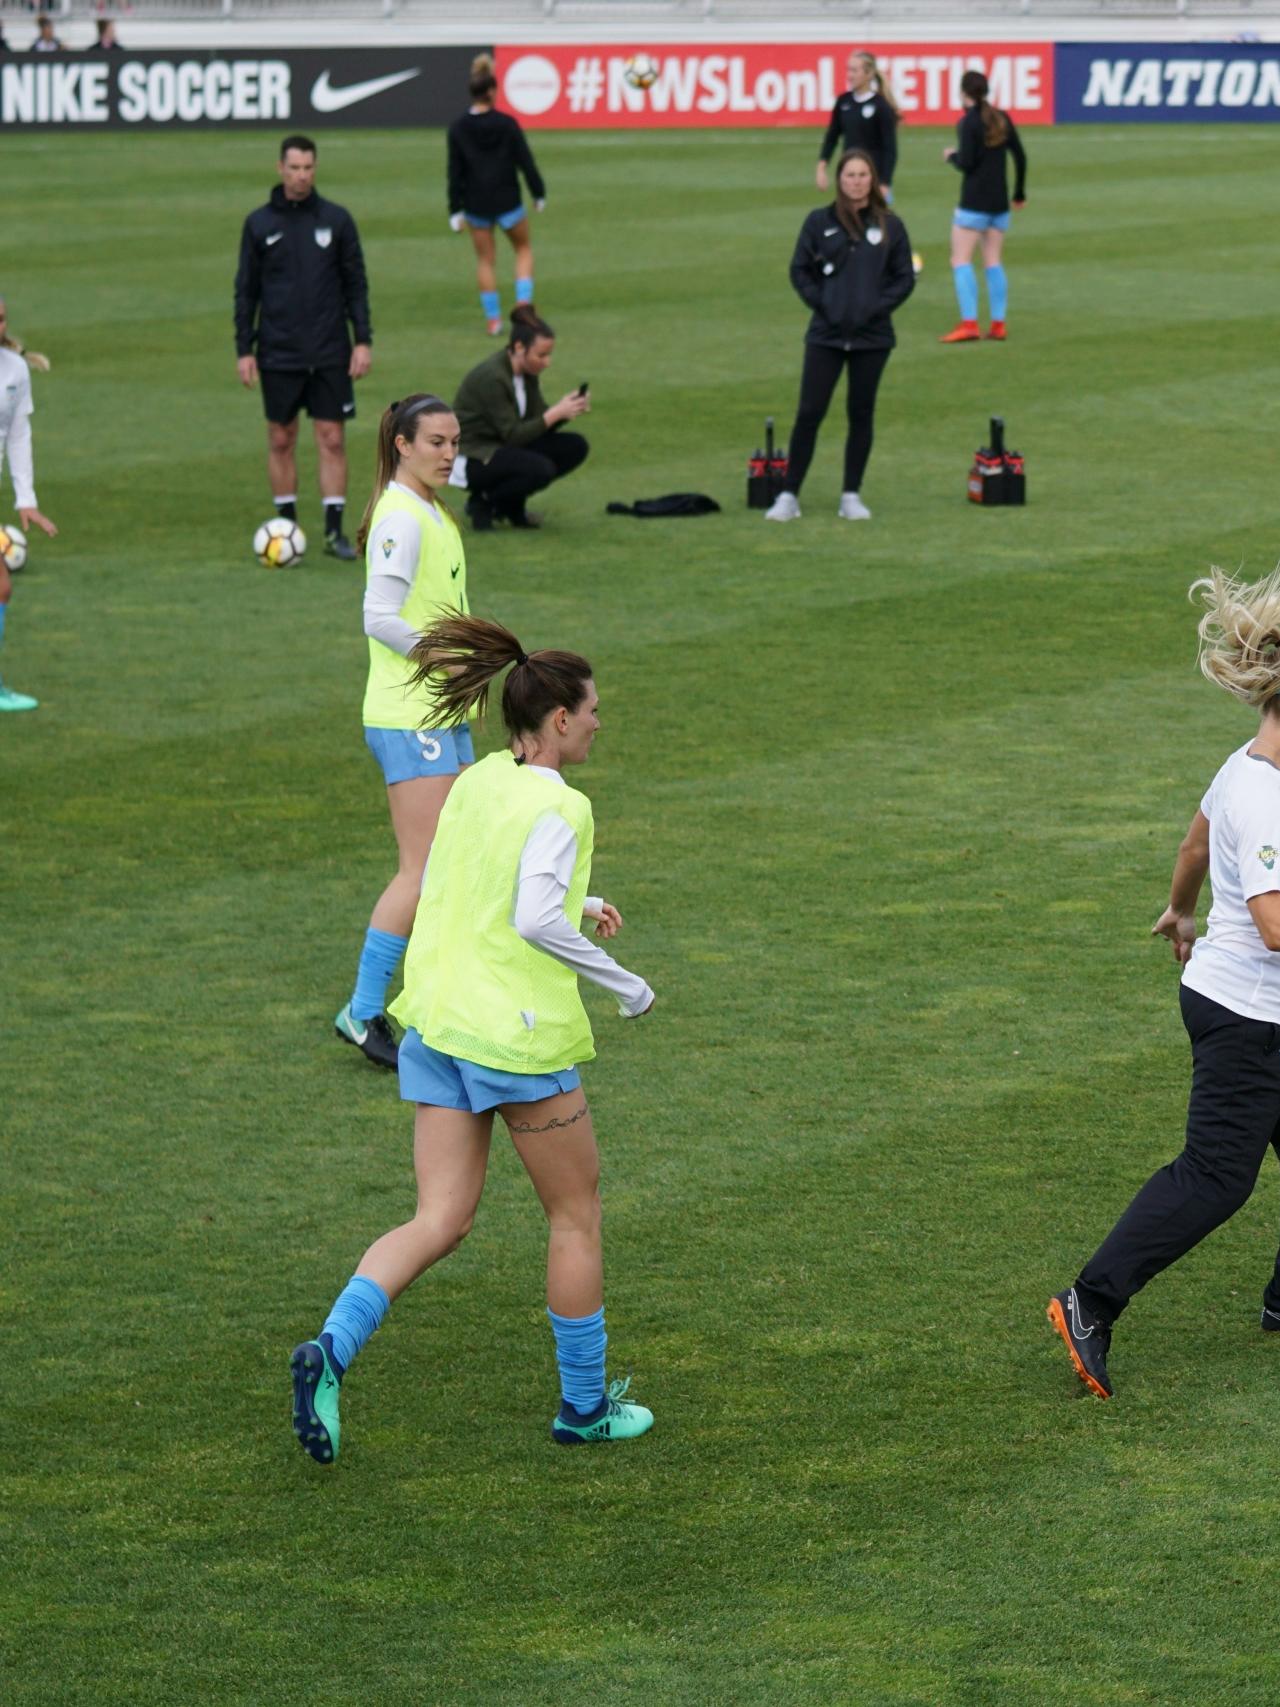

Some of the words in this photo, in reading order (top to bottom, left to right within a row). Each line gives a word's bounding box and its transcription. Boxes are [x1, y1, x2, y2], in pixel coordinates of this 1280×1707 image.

[2, 63, 109, 122] NIKE
[118, 61, 291, 121] SOCCER
[416, 730, 442, 761] 5
